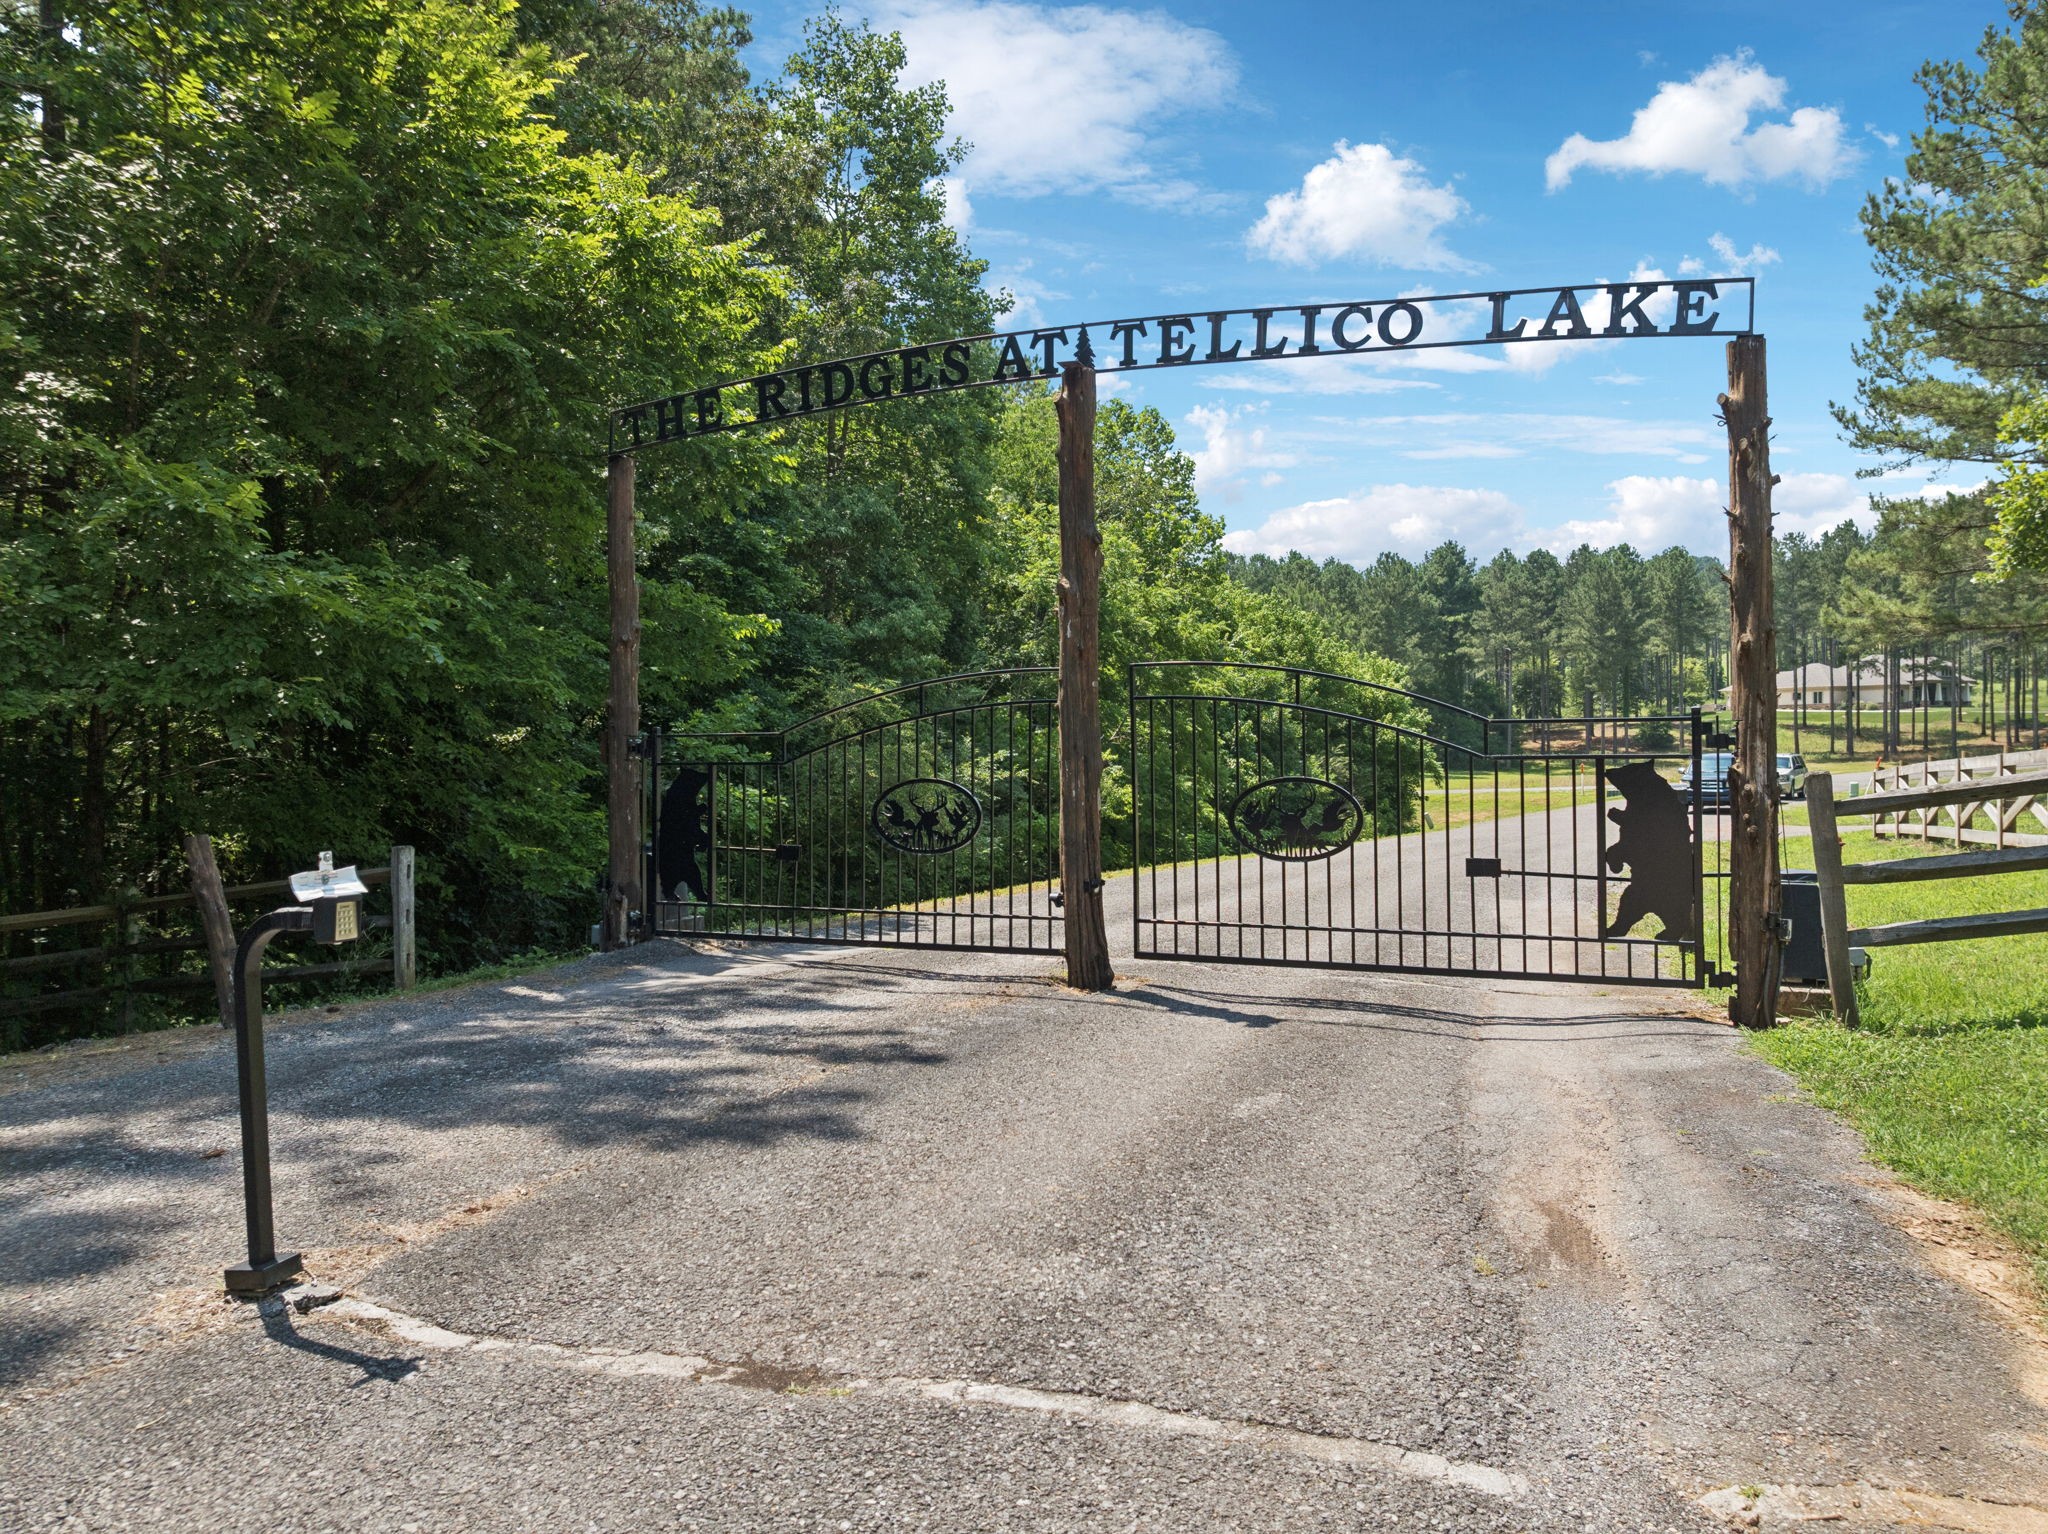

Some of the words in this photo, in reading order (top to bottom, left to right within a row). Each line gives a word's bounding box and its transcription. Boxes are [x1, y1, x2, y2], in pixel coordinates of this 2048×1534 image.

[621, 388, 724, 446] THE
[755, 344, 971, 421] RIDGES
[994, 328, 1069, 381] AT
[1110, 302, 1425, 367] TELLICO
[1486, 282, 1720, 339] LAKE
